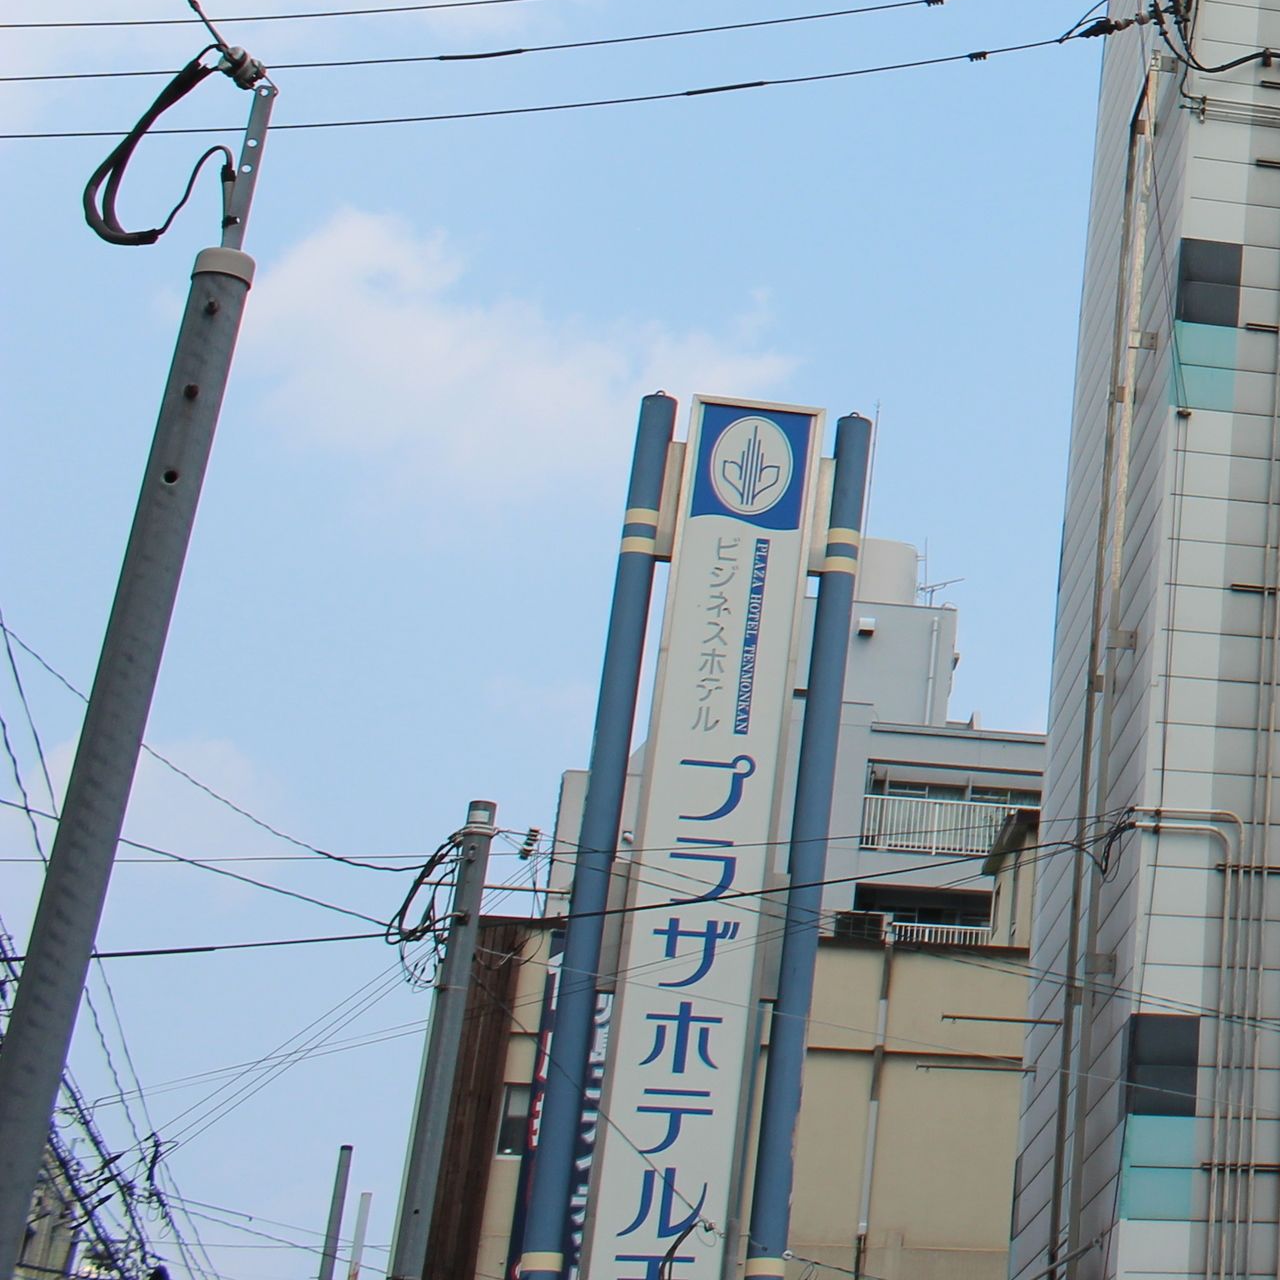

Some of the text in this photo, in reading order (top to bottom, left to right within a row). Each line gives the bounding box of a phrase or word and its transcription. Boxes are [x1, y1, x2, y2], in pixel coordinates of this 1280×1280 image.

[691, 536, 741, 732] ビジネスホテル
[734, 542, 768, 732] PLAZA HOTEL TENMONKAN
